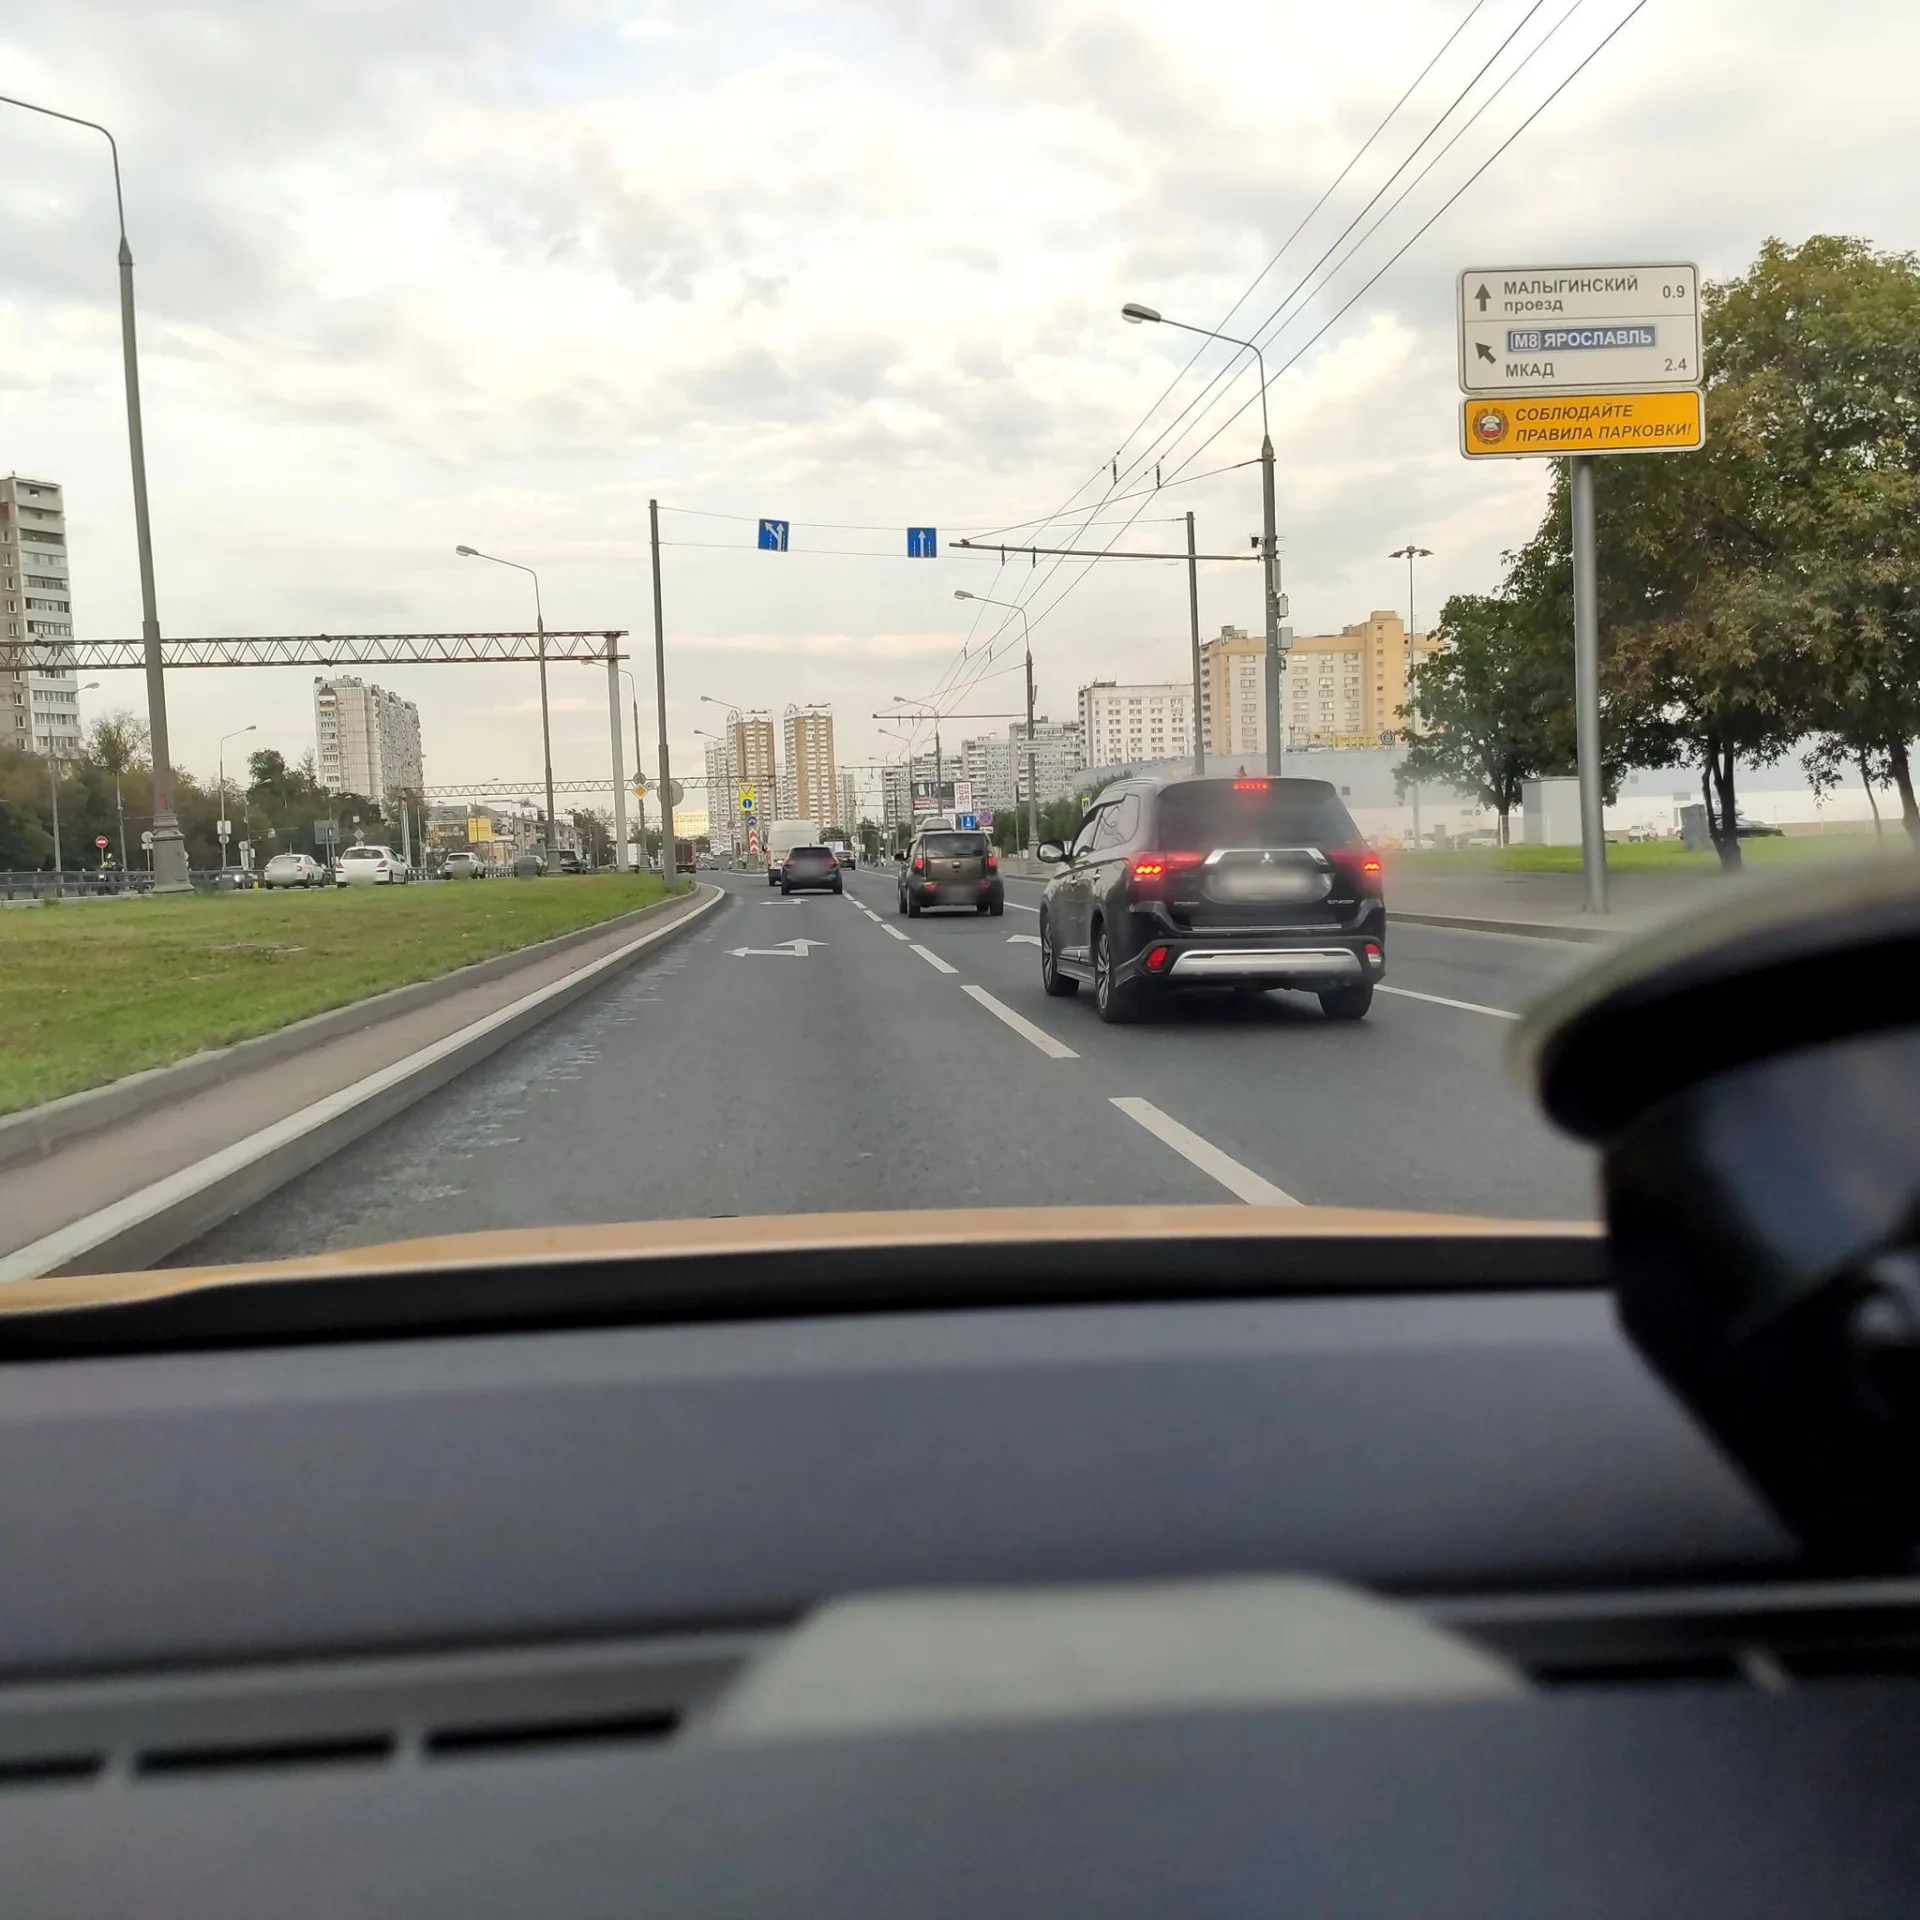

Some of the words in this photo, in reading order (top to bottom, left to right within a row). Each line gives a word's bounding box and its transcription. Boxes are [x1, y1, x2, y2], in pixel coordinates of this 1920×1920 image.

[1504, 274, 1638, 295] МАЛЫГИНСКИЙ
[1662, 285, 1685, 298] 0.9
[1504, 299, 1563, 314] проезд
[1513, 332, 1539, 349] М8
[1544, 330, 1652, 347] ЯРОСЛАВЛЬ
[1505, 363, 1555, 379] МКАД
[1664, 358, 1687, 372] 2.4
[1515, 402, 1633, 422] СОБЛЮДАЙТЕ
[1516, 427, 1593, 442] ПРАВИЛА
[1598, 423, 1692, 440] ПАРКОВКИ!
